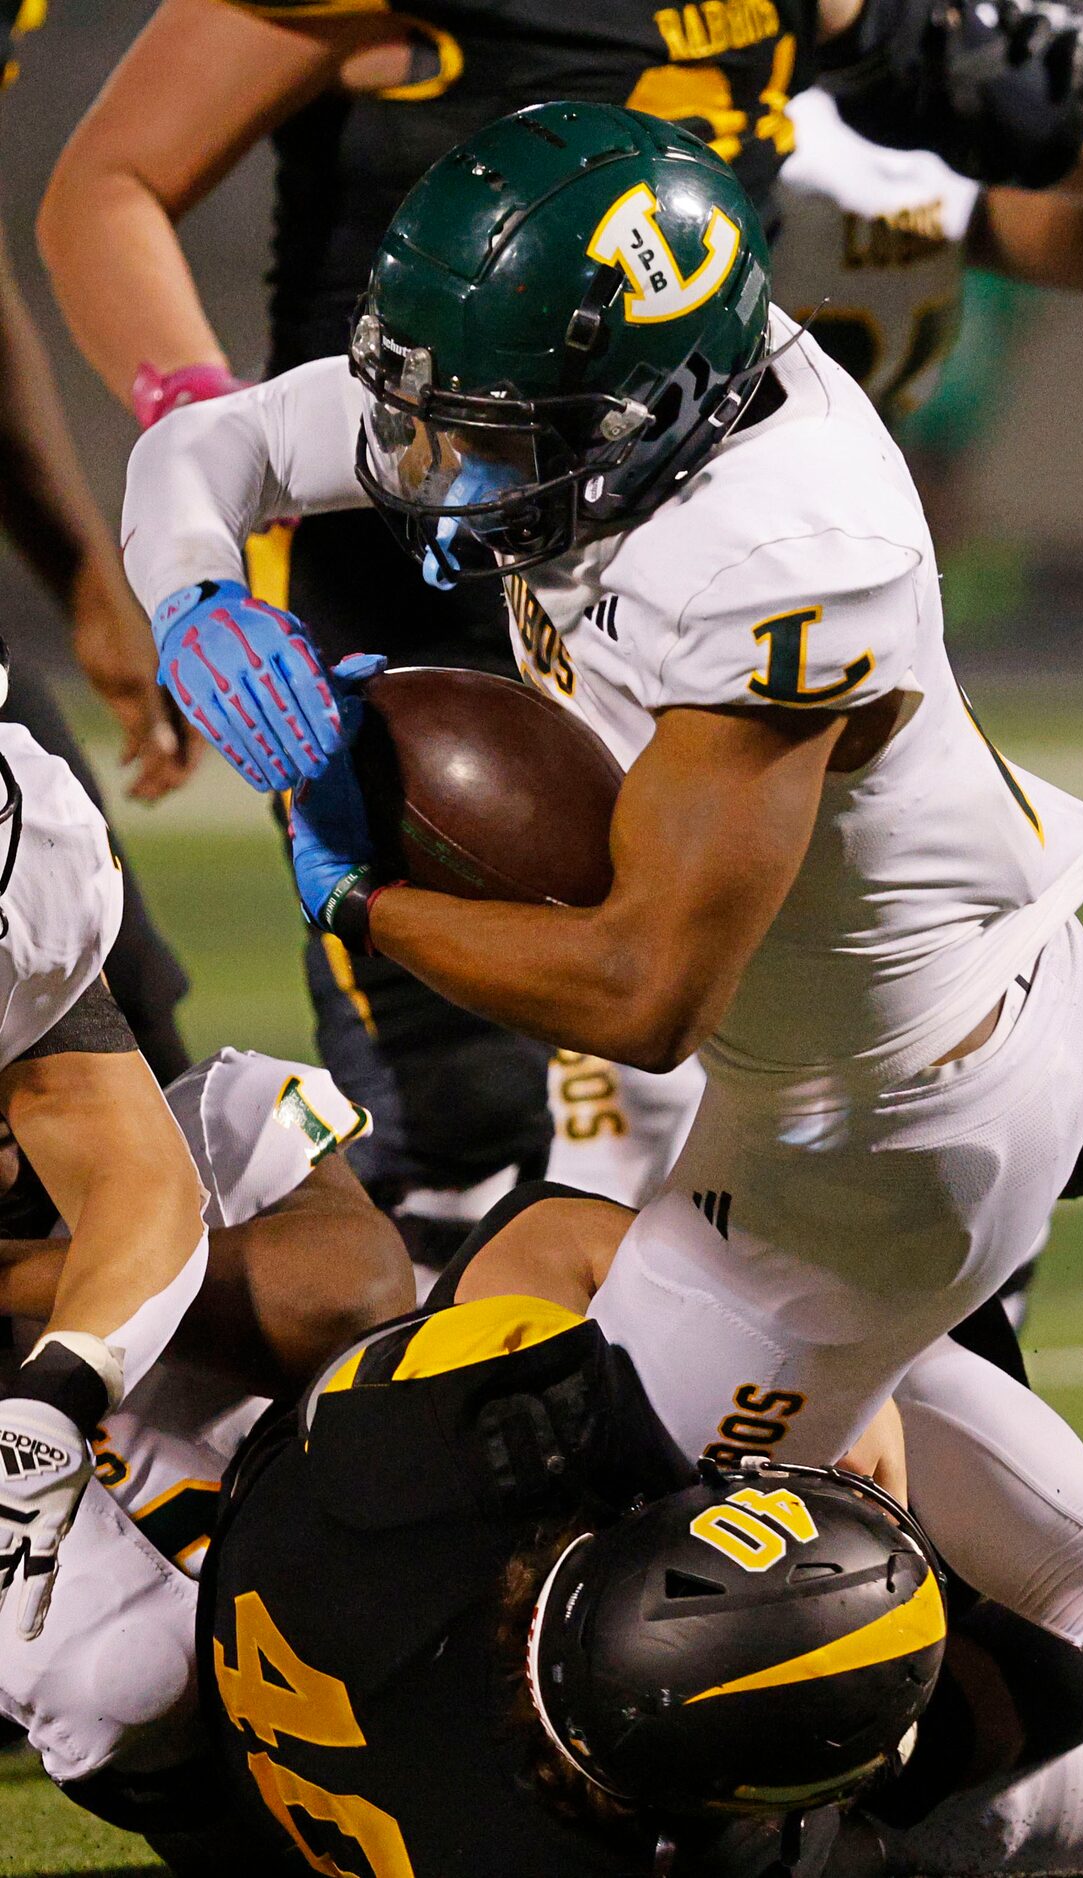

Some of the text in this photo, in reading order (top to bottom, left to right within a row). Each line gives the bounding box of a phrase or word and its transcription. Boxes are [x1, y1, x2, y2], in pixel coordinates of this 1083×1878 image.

[586, 181, 741, 325] L
[630, 228, 668, 293] JPB
[747, 603, 877, 709] L
[689, 1487, 819, 1572] 40
